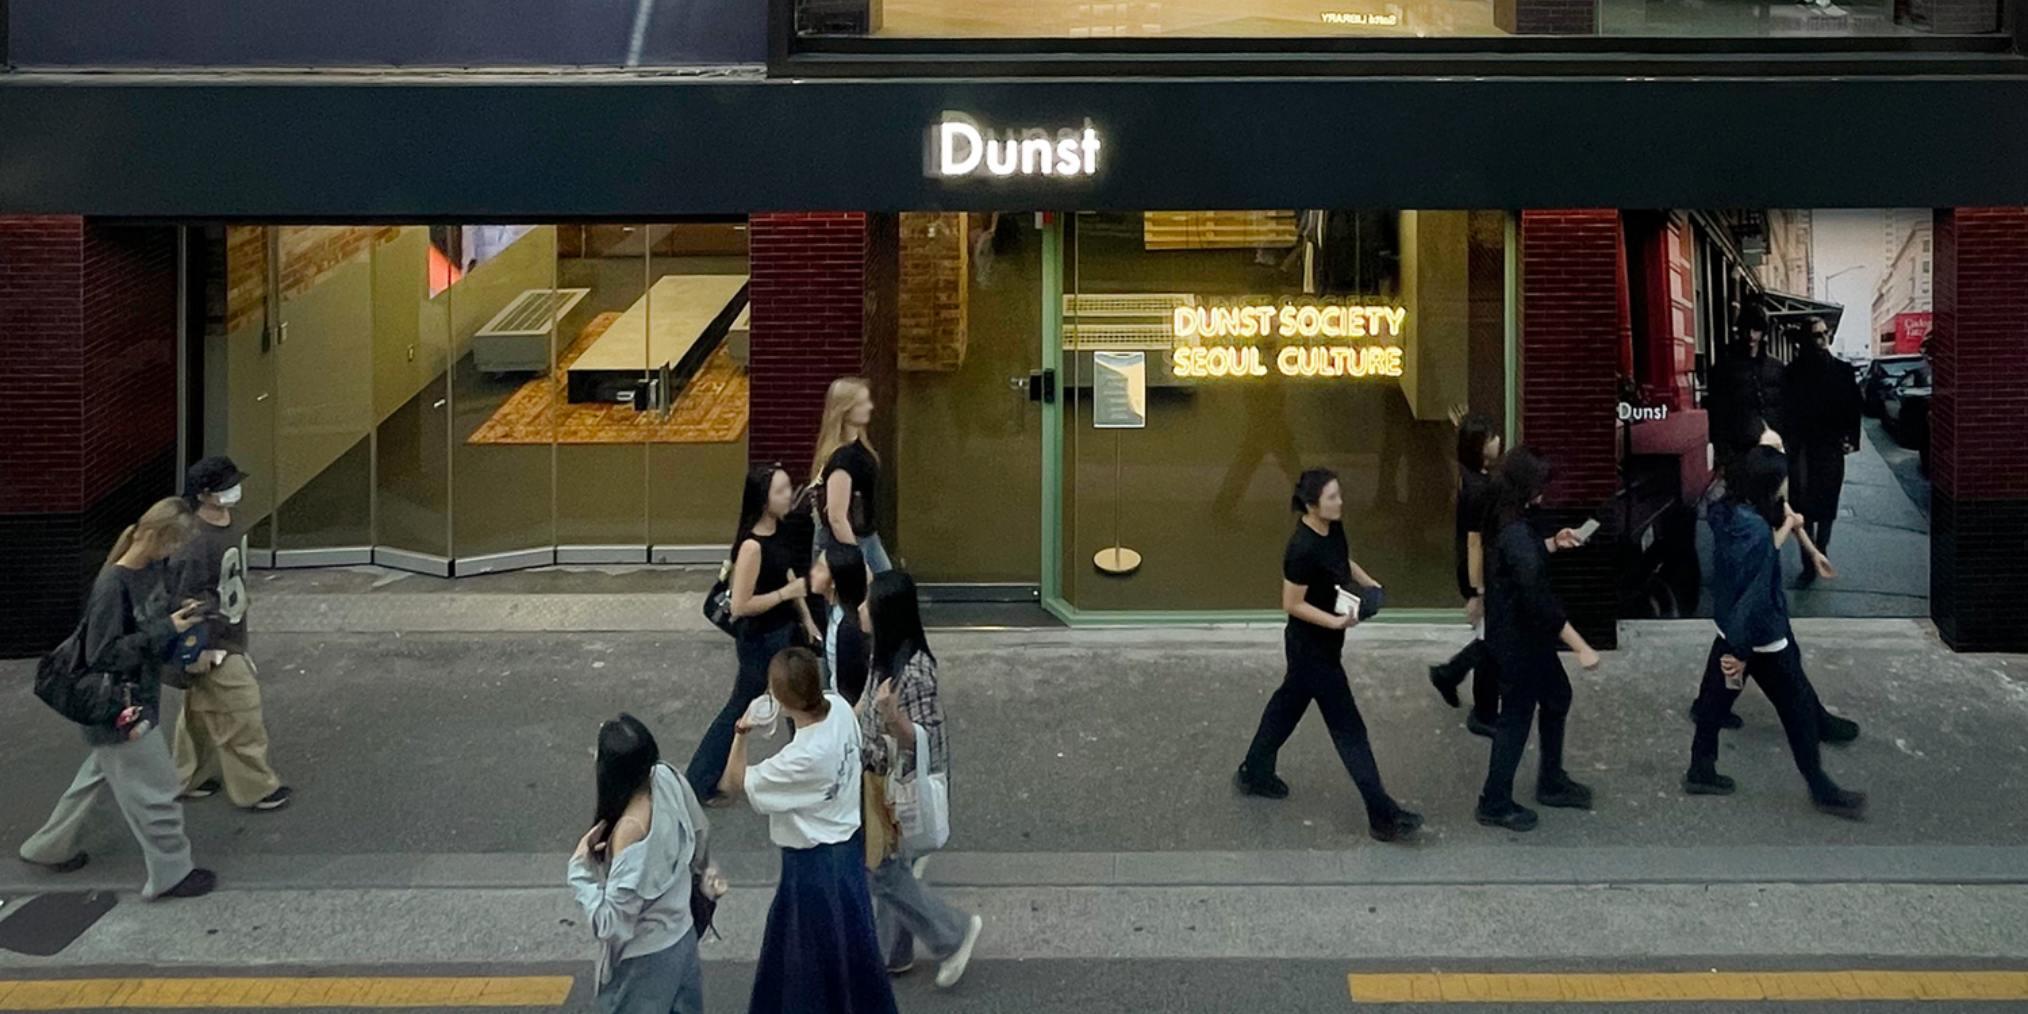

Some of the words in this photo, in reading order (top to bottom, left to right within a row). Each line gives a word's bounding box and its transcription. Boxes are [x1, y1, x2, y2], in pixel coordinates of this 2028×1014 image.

[941, 121, 1101, 176] Dunst
[1173, 306, 1276, 337] DUNST
[1278, 305, 1406, 337] SOCIETY
[1173, 345, 1268, 376] SEOUL
[1277, 345, 1403, 377] CULTURE
[1618, 401, 1668, 420] Dunst
